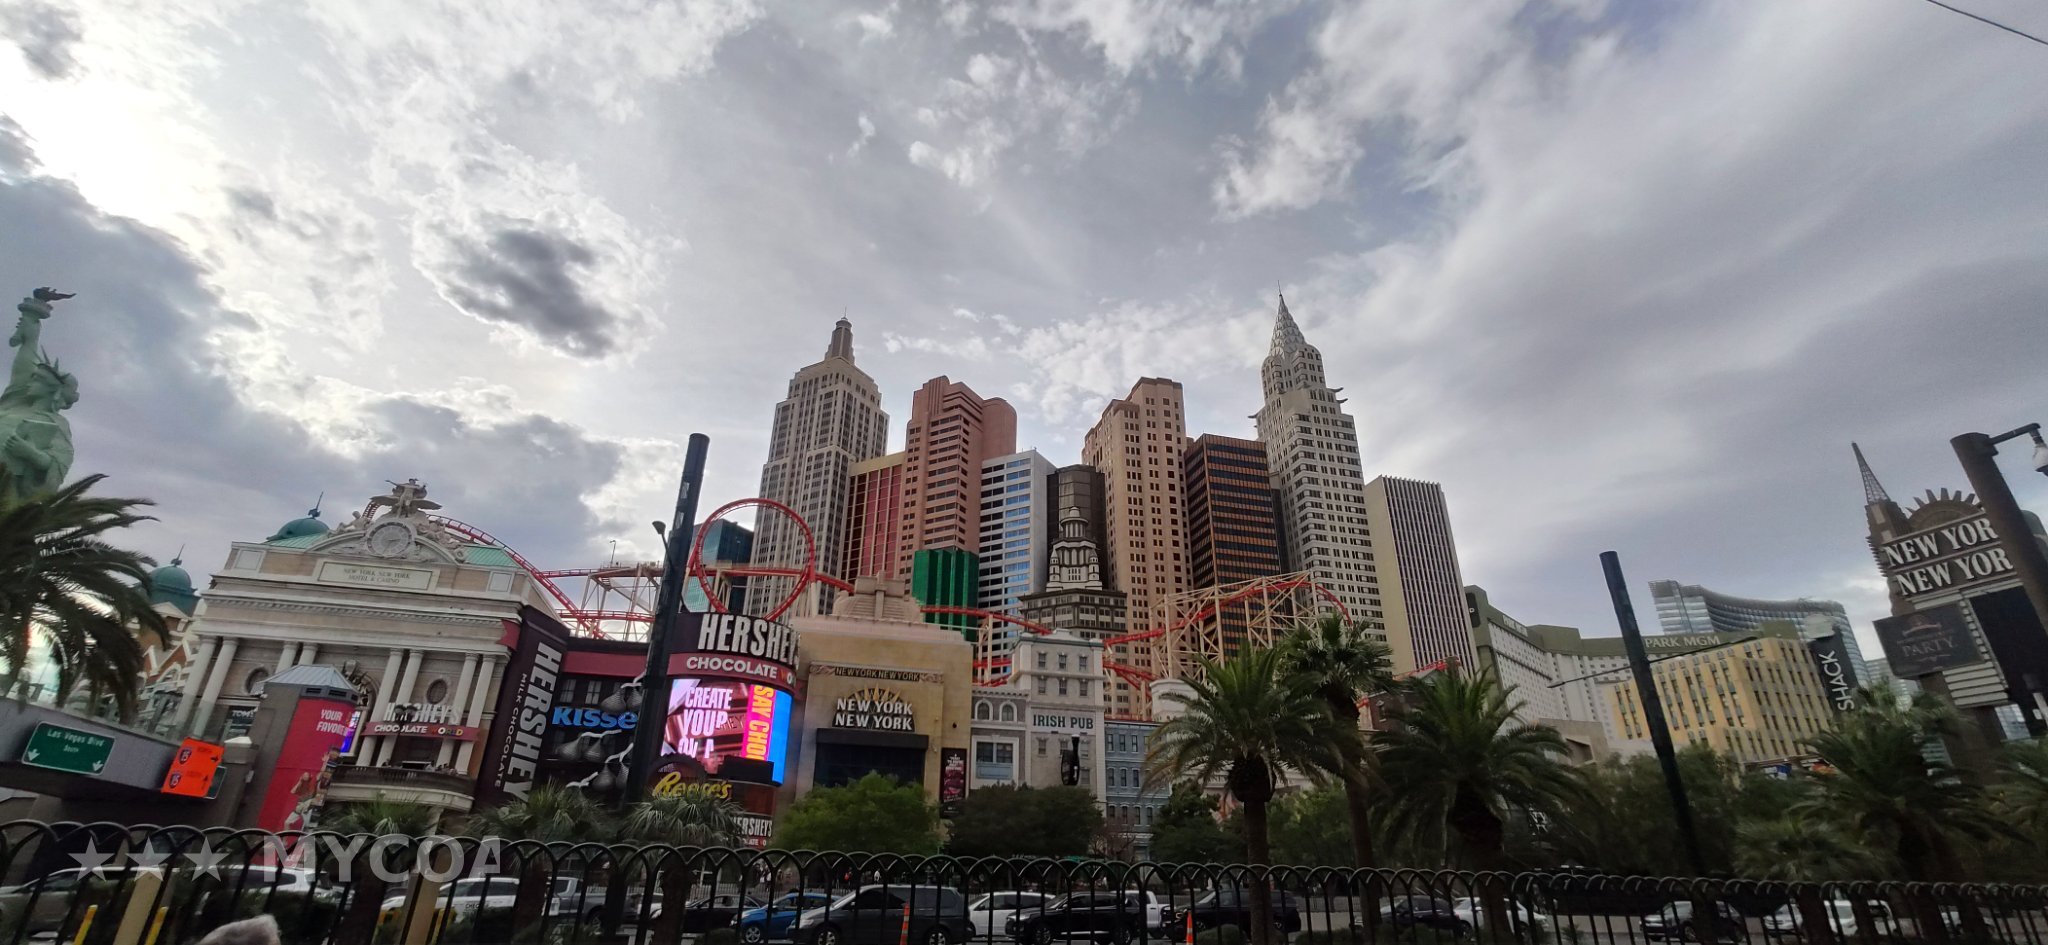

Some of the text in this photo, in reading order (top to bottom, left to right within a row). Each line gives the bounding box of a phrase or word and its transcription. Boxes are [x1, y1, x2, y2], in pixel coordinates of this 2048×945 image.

[1883, 517, 1999, 567] NEW YOR
[1896, 548, 2014, 596] NEW YOR
[1644, 635, 1721, 648] PARK MGM
[686, 657, 778, 679] CHOCOLATE
[1818, 650, 1855, 711] SHACK
[684, 686, 733, 709] CREATE
[751, 685, 775, 719] SAY
[837, 697, 913, 715] NEW YORK
[320, 709, 343, 721] YOUR
[503, 642, 562, 802] HERSHEY
[835, 712, 913, 731] NEW YORK
[1033, 714, 1094, 730] IRISH PUB
[47, 729, 105, 747] Las Vegas Blvd
[495, 673, 528, 788] MILK CHOCOLATE
